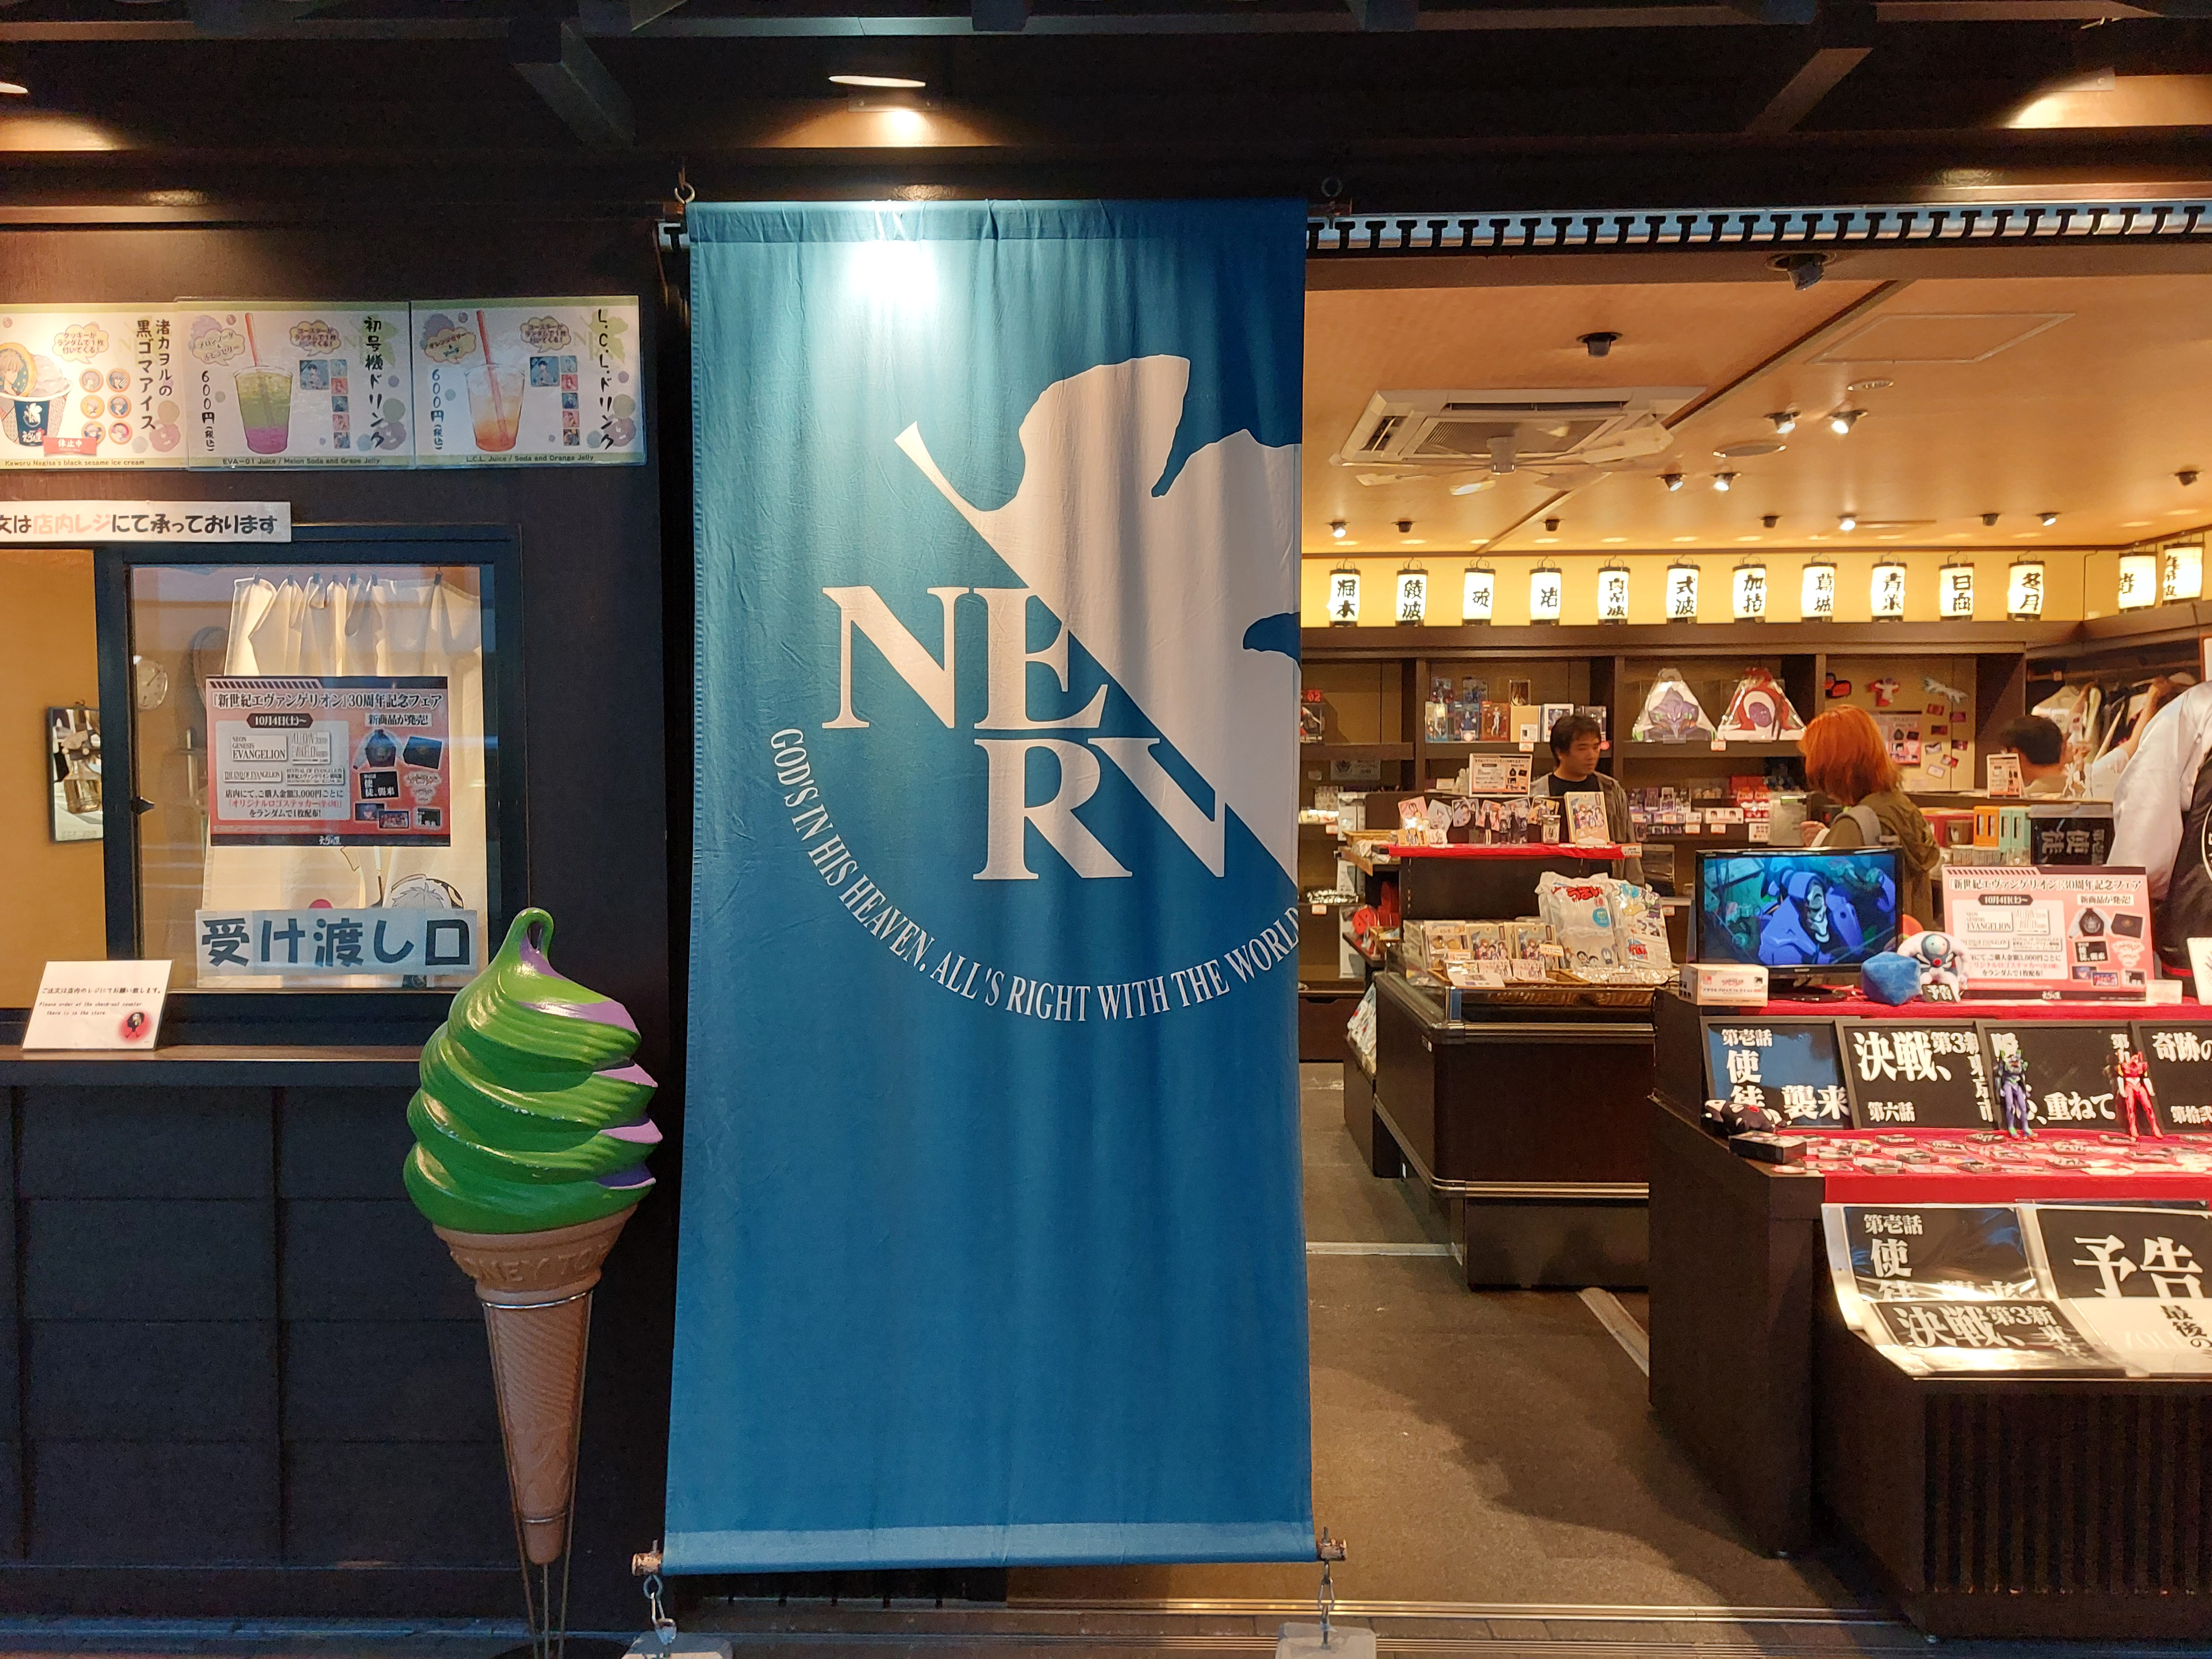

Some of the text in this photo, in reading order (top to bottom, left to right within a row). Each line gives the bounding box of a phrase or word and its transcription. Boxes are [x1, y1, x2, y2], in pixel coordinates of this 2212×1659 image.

[136, 320, 156, 430] 黒ゴマアイス
[156, 319, 173, 397] 渚カヲルの
[364, 316, 384, 449] 初号機ドリンク
[597, 309, 614, 451] L.C.L.ドリンク
[232, 750, 286, 760] EVANGELION
[770, 728, 819, 807] GOD'S
[791, 803, 834, 841] IN
[807, 833, 859, 886] HIS
[201, 918, 471, 968] 受け渡し口
[838, 874, 936, 973] HEAVEN.
[1967, 922, 2012, 931] EVANGELION
[929, 951, 1002, 1008] ALL'S
[1006, 976, 1091, 1023] RIGHT
[1097, 975, 1171, 1022] WITH
[1170, 959, 1230, 1007] THE
[1868, 1101, 1916, 1123] 第六話
[1863, 1214, 1924, 1235] 第壱話
